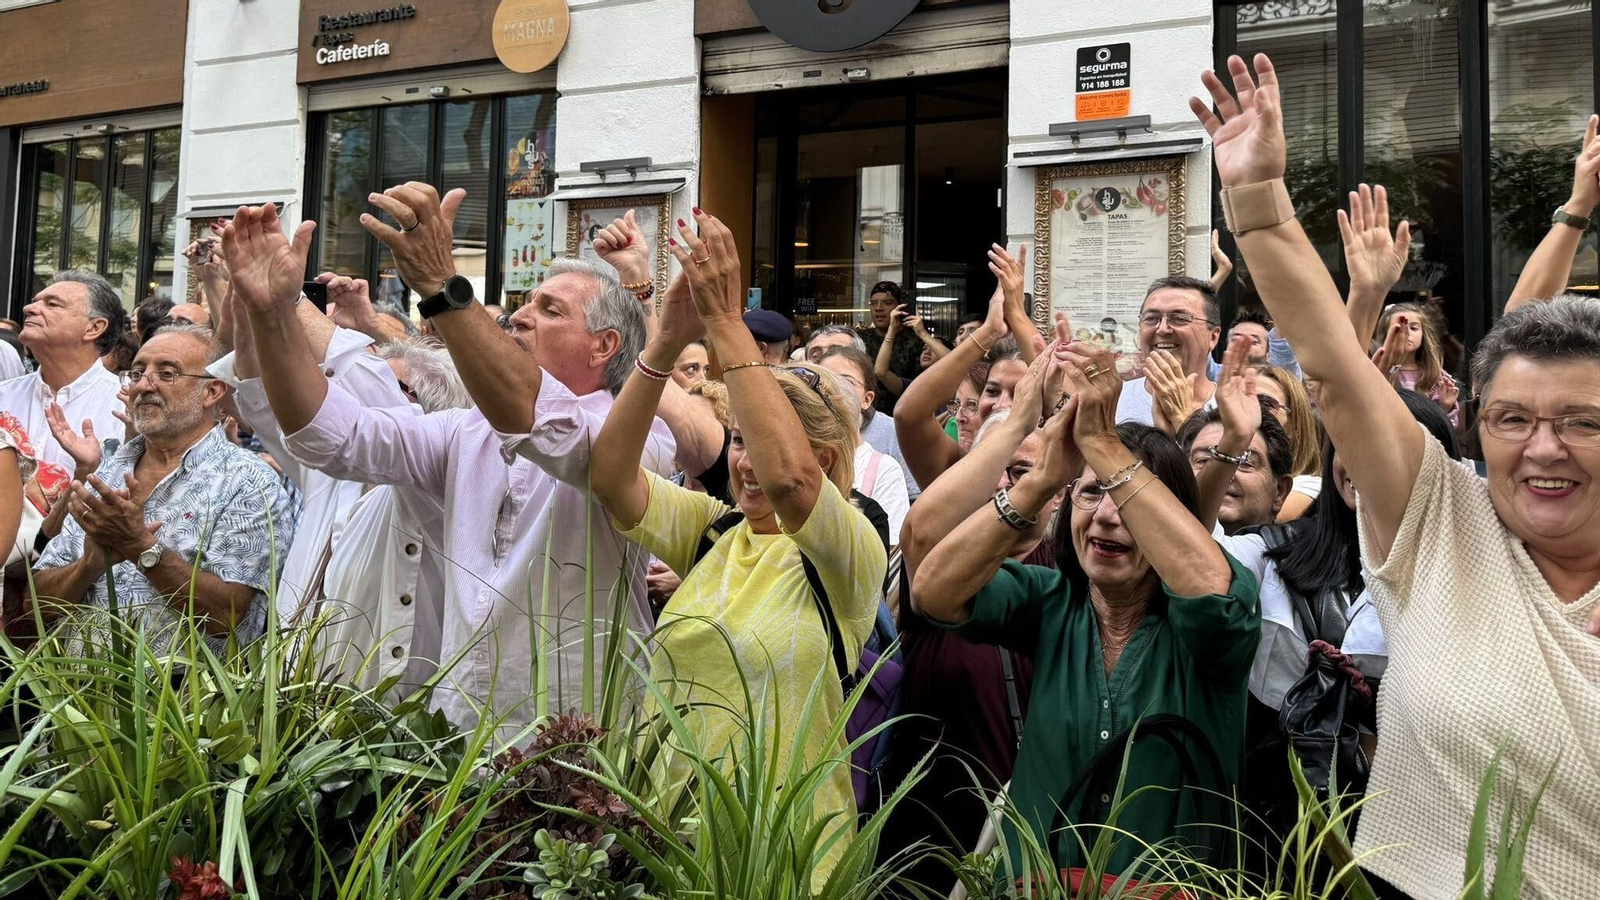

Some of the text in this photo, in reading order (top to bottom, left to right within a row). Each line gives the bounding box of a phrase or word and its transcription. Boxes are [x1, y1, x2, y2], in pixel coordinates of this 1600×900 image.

[318, 3, 416, 31] Restaurante
[503, 17, 556, 41] MAGNA
[316, 39, 390, 65] Cafetería
[1079, 61, 1128, 74] segurma
[1081, 79, 1125, 90] 914 188 188
[797, 297, 816, 306] FREE
